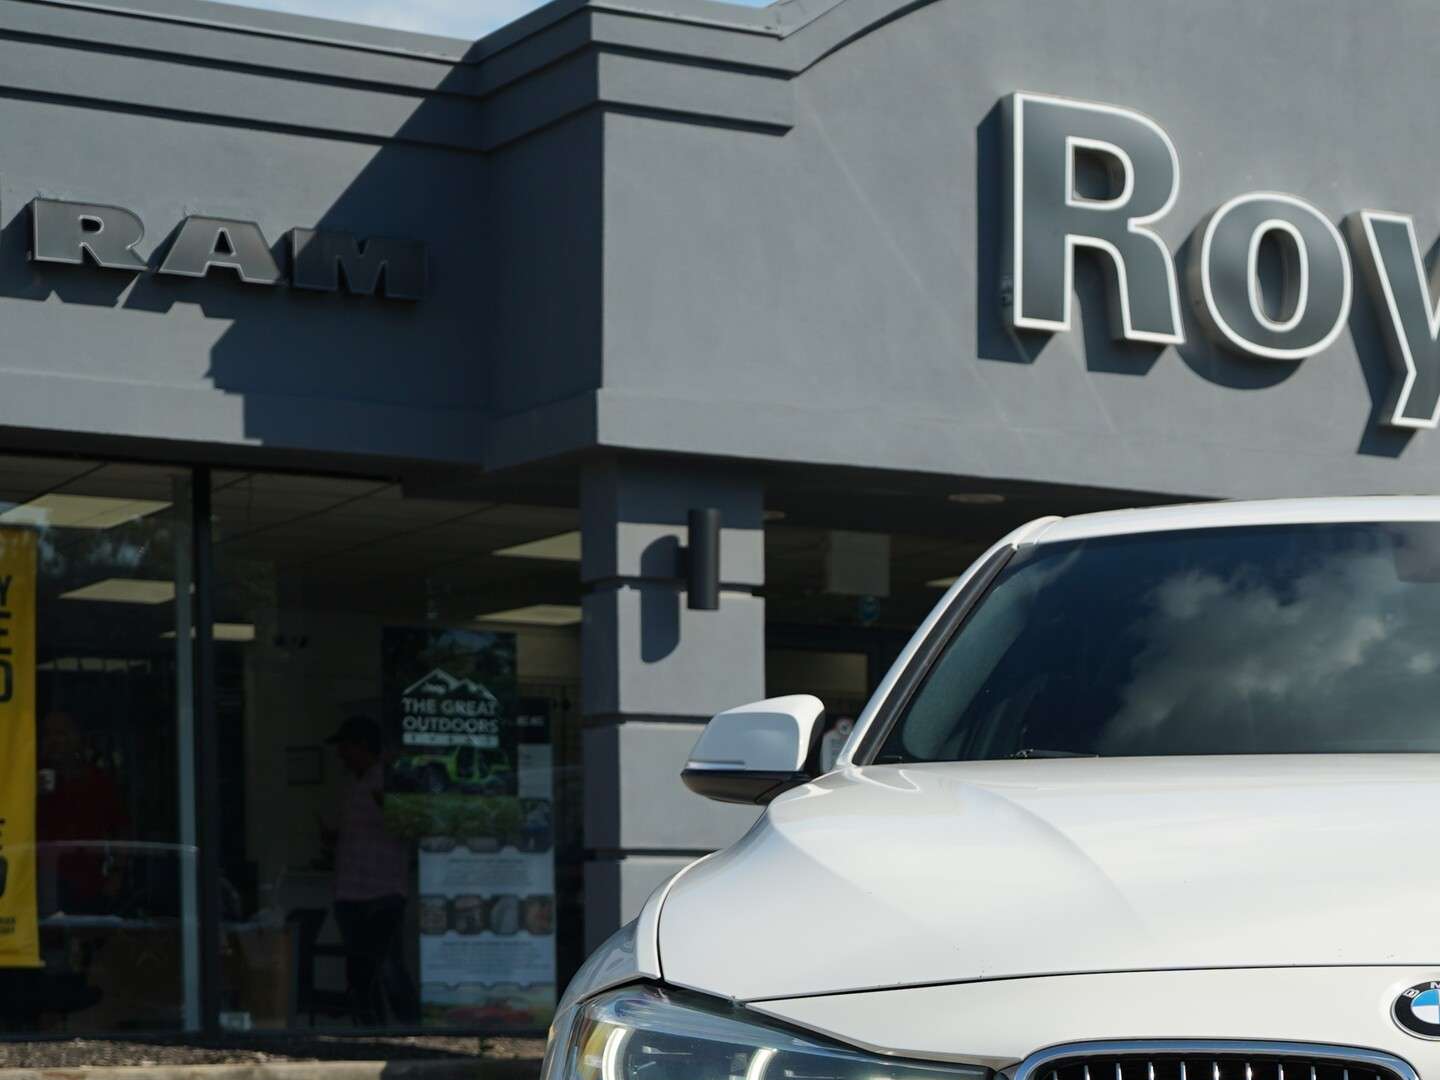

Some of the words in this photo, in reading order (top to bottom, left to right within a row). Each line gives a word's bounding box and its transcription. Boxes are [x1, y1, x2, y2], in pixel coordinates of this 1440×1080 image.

[32, 198, 428, 299] RAM
[402, 697, 436, 714] THE
[441, 698, 496, 716] GREAT
[402, 715, 499, 733] OUTDOORS
